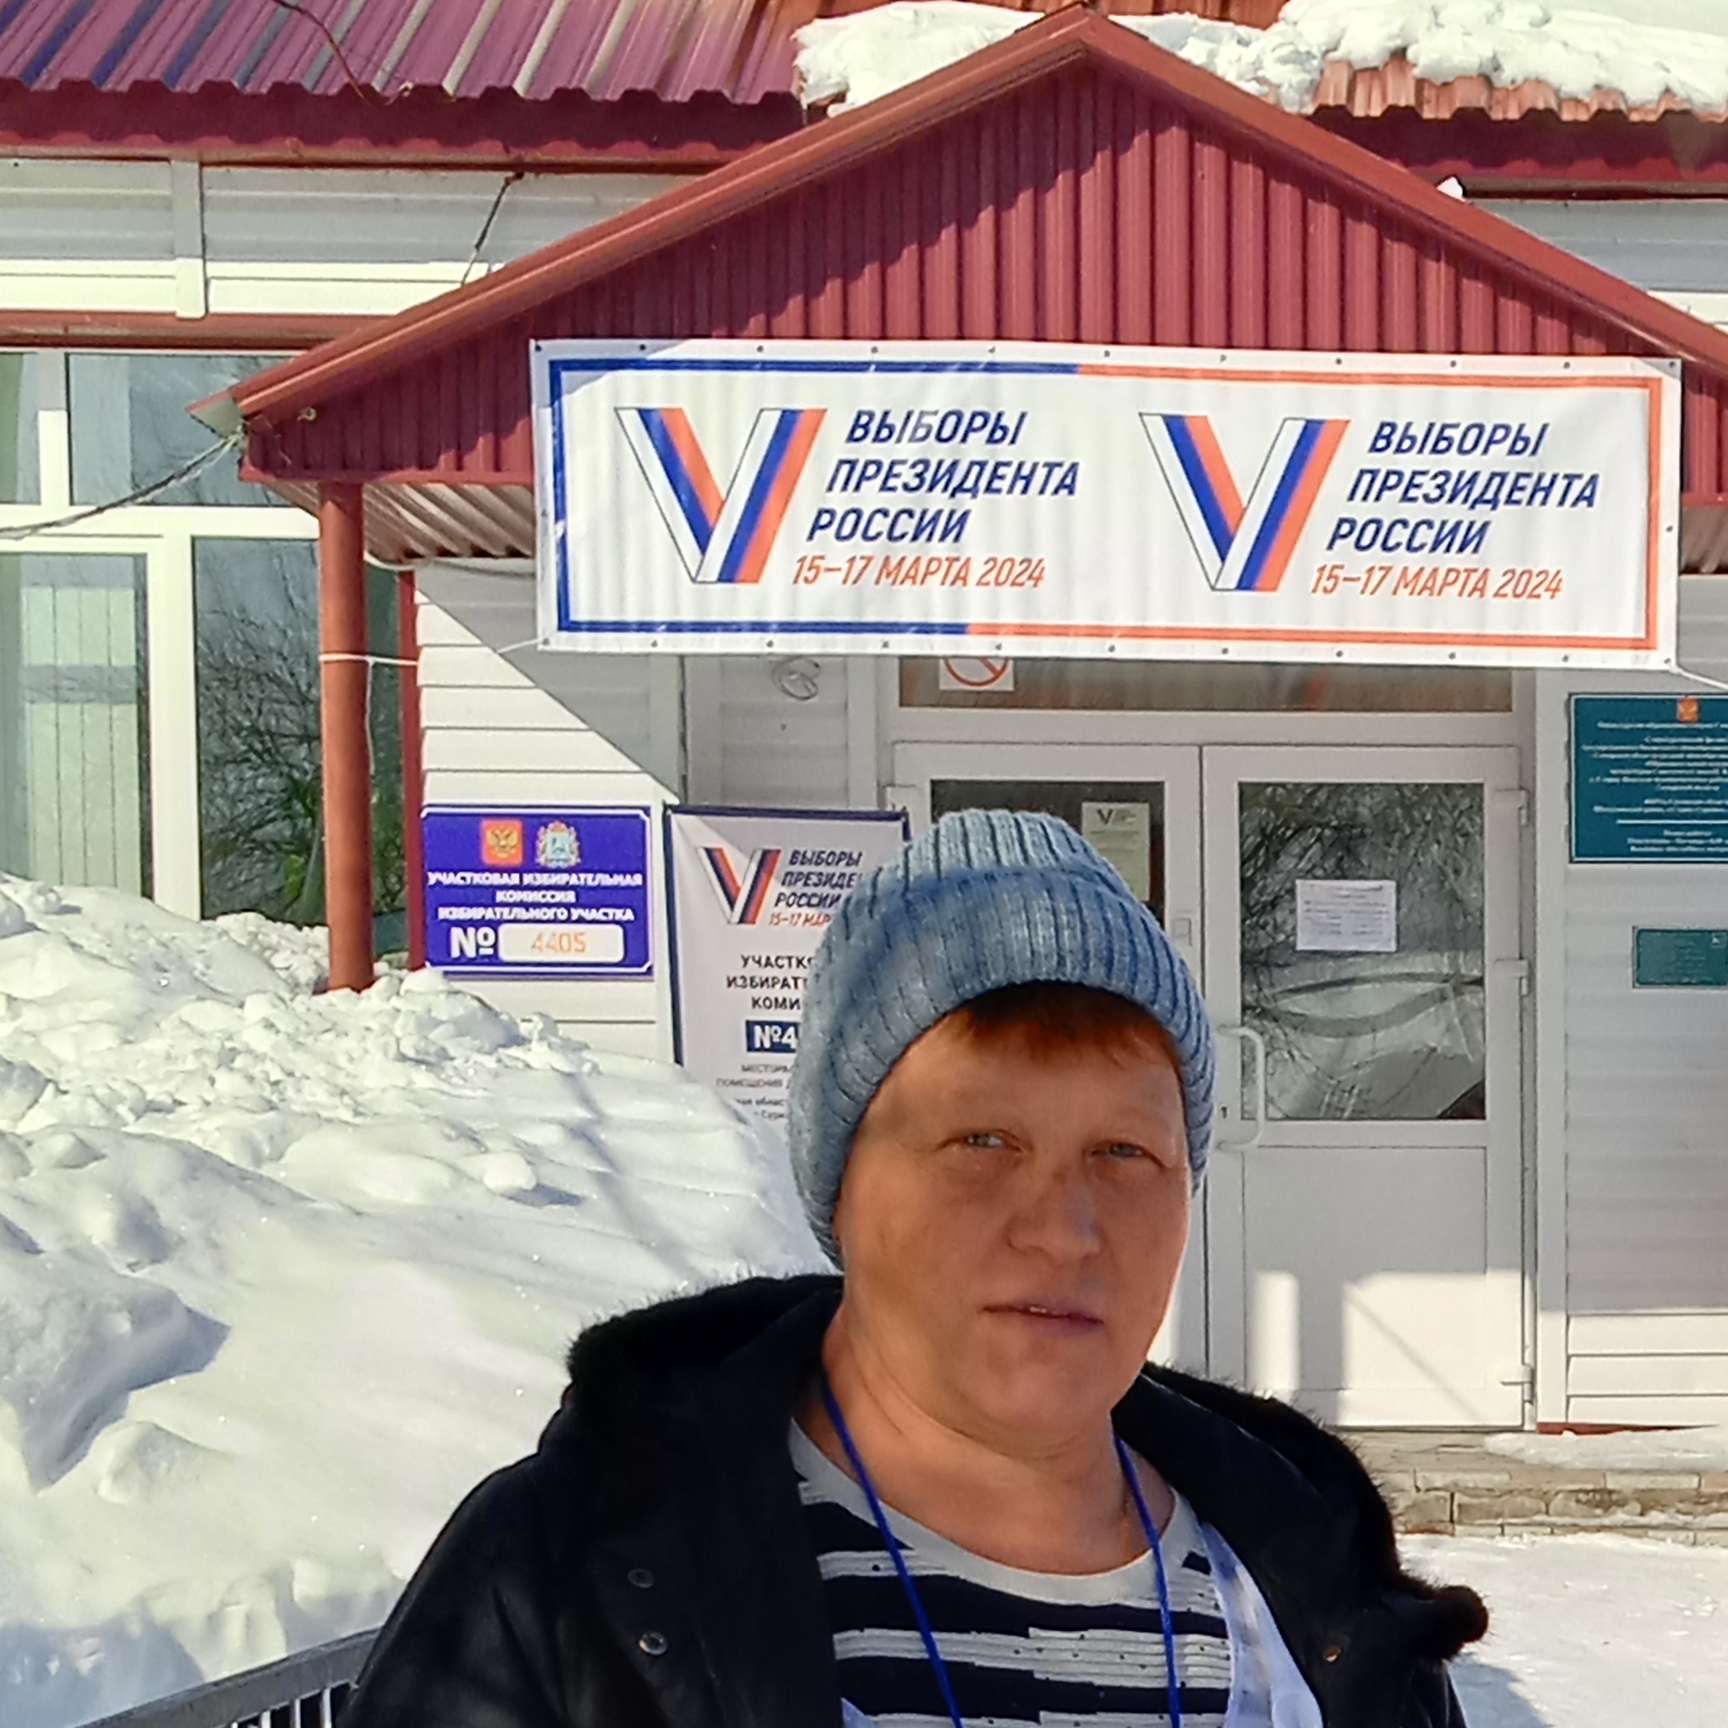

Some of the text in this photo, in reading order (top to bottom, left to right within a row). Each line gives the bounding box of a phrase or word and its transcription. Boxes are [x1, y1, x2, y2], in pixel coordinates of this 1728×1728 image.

[845, 409, 1027, 446] ВЫБОРЫ
[1368, 421, 1549, 457] ВЫБОРЫ
[826, 458, 1079, 499] ПРЕЗИДЕНТА
[1347, 469, 1599, 511] ПРЕЗИДЕНТА
[807, 508, 971, 543] РОССИИ
[1327, 518, 1490, 554] РОССИИ
[874, 556, 970, 587] МАРТА
[975, 557, 1046, 588] 2024
[1392, 566, 1490, 598] МАРТА
[1494, 569, 1564, 600] 2024
[789, 850, 863, 866] ВЫБОРЫ
[428, 872, 643, 886] УЧАСТКОВАЯ ИЗБИРАТЕЛЬНАЯ
[781, 871, 862, 889] ПРЕЗИДЕ
[496, 890, 576, 903] КОМИССИЯ
[774, 892, 841, 908] РОССИИ
[438, 907, 635, 921] ИЗБИРАТЕЛЬНОГО УЧАСТКА
[803, 913, 832, 926] МАР
[450, 926, 587, 958] № 4405
[741, 954, 815, 969] УЧАСТК
[726, 975, 808, 989] ИЗБИРАТ
[751, 996, 801, 1010] КОМИ
